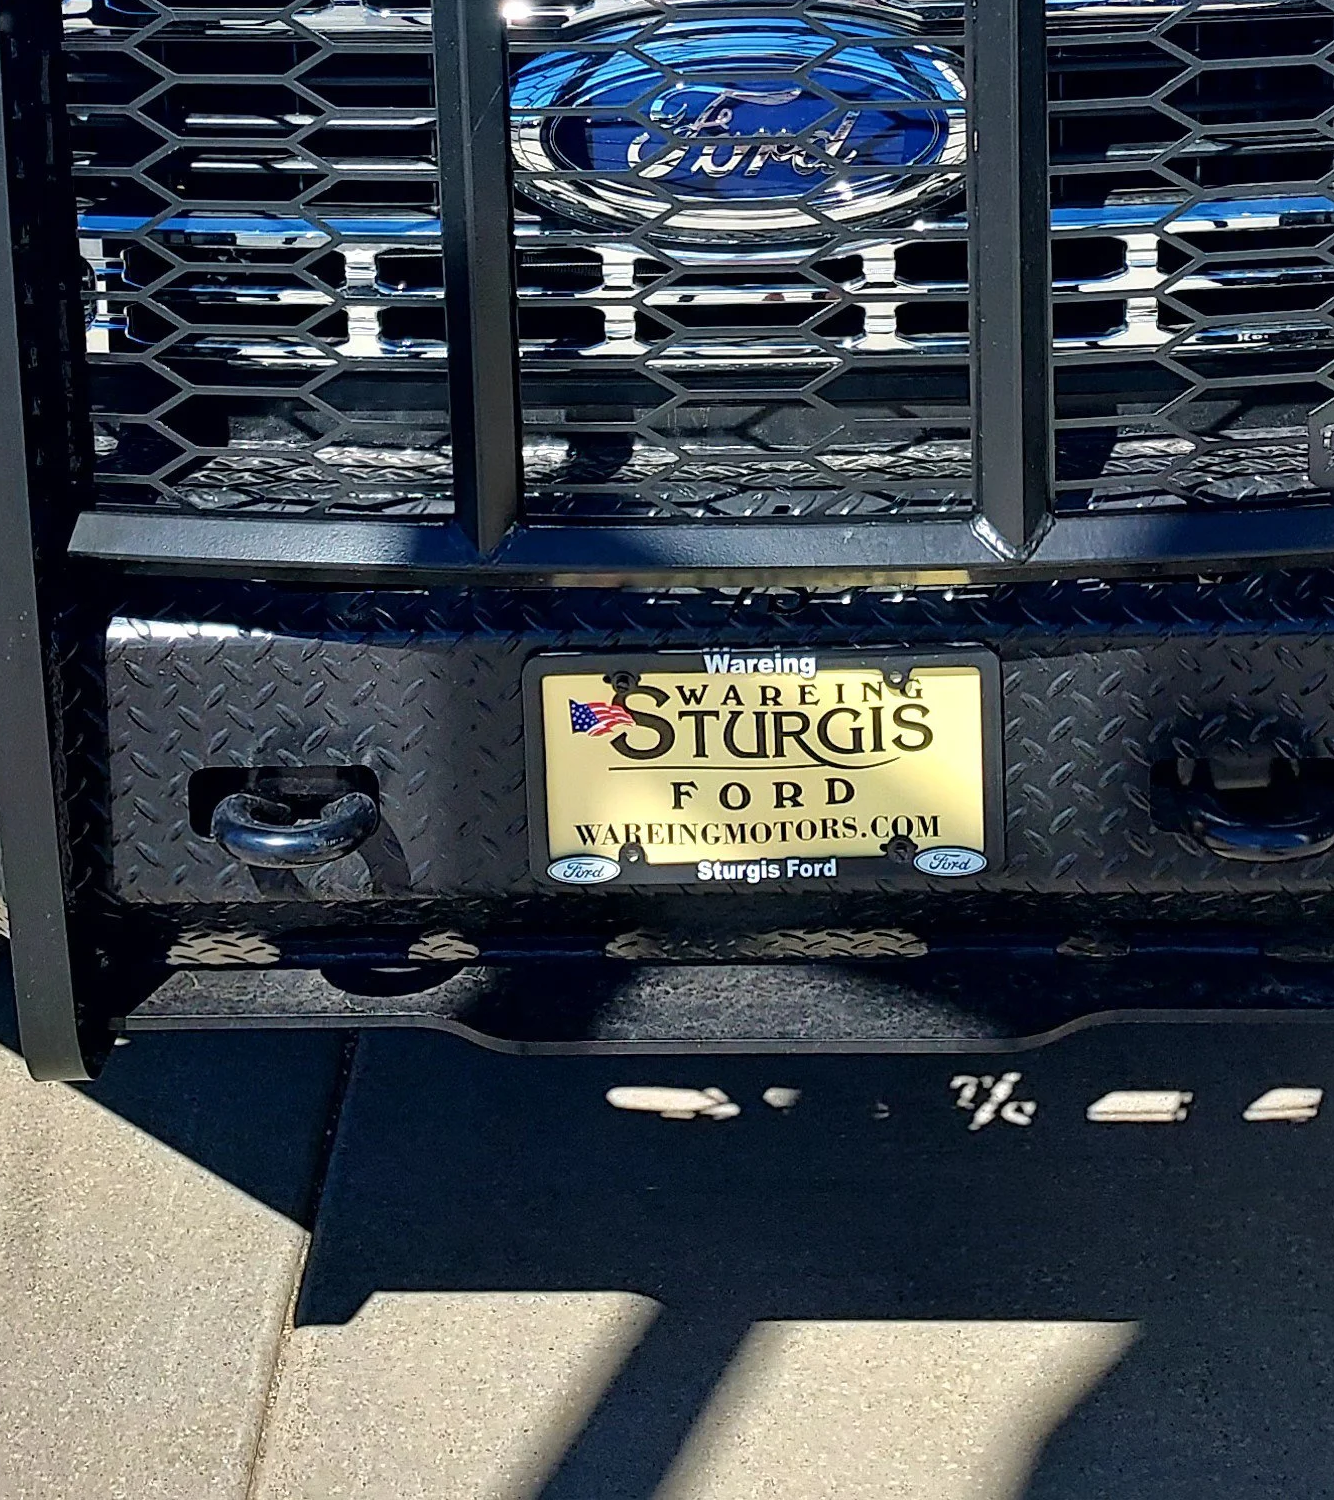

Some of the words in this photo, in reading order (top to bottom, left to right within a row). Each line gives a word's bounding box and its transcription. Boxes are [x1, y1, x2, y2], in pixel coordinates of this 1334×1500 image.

[627, 86, 863, 178] Ford
[703, 652, 817, 680] Wareing
[675, 682, 925, 708] WAREING
[609, 685, 935, 770] STURGIS
[671, 777, 857, 811] FORD
[574, 814, 942, 847] WAREINGMOTORS.COM
[563, 863, 607, 881] Ford
[697, 859, 781, 883] Sturgis
[786, 857, 838, 879] Ford
[928, 852, 973, 873] Ford
